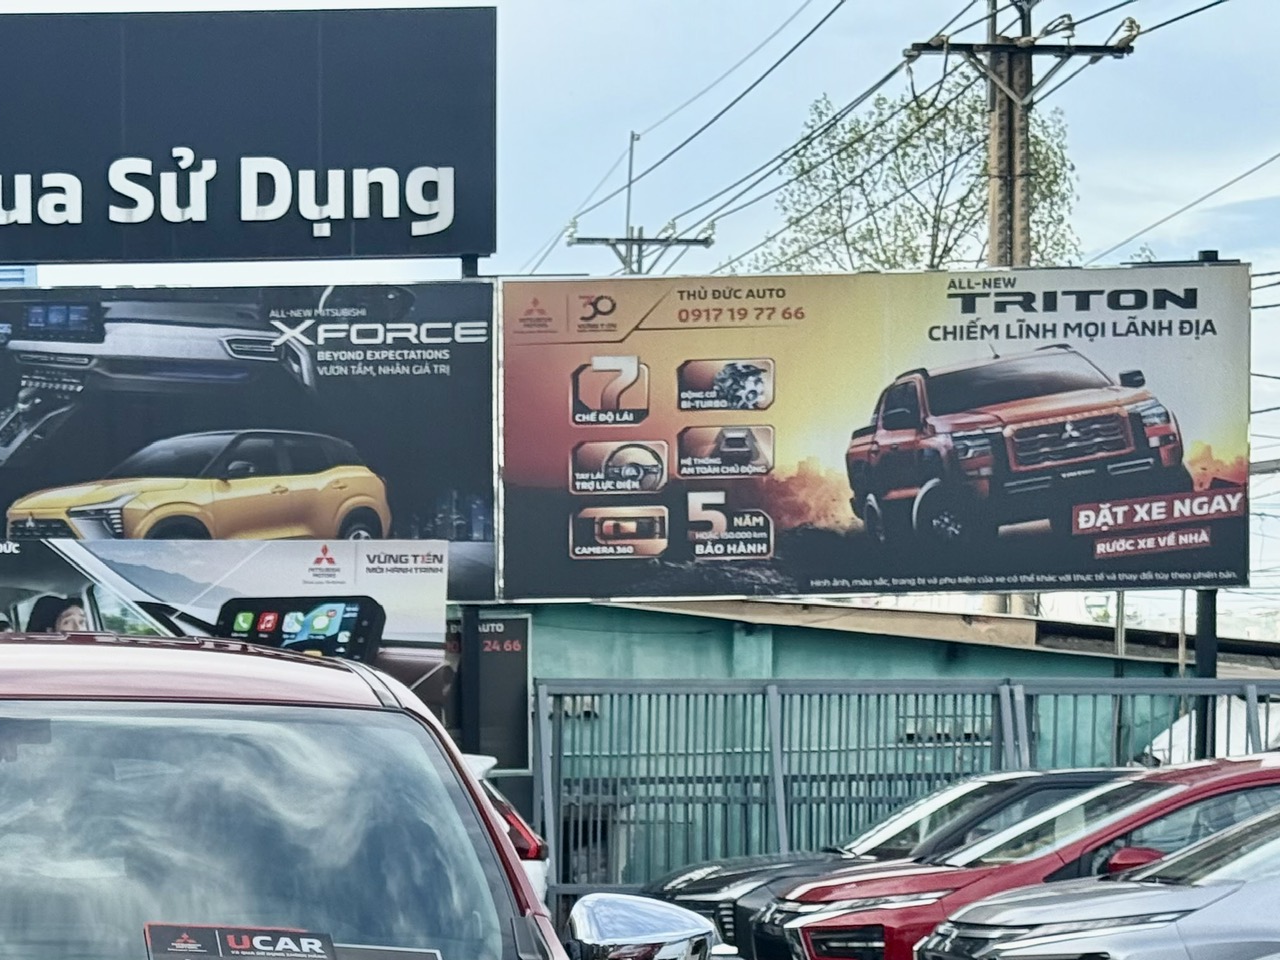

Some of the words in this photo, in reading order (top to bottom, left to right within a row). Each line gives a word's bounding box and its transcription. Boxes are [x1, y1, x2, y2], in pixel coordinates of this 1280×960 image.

[108, 146, 217, 225] Sử
[239, 156, 456, 237] Dụng
[947, 277, 1017, 290] ALL-NEW
[677, 287, 708, 300] THỦ
[711, 287, 742, 300] ĐỨC
[745, 287, 786, 299] AUTO
[946, 288, 1198, 314] TRITON
[270, 310, 312, 318] ALL-NEW
[315, 308, 367, 317] MITSUBISHI
[677, 307, 722, 323] 0917
[727, 308, 748, 321] 19
[753, 307, 777, 321] 77
[781, 306, 805, 320] 66
[270, 319, 488, 346] XFORCE
[928, 317, 1000, 341] CHIẾM
[1006, 318, 1057, 339] LĨNH
[1064, 321, 1106, 342] MỌI
[1113, 315, 1171, 337] LÃNH
[1179, 318, 1218, 340] ĐỊA
[317, 350, 364, 361] BEYOND
[367, 350, 450, 360] EXPECTATIONS
[591, 356, 639, 410] 7
[575, 411, 597, 422] CHẾ
[598, 411, 615, 423] ĐỘ
[616, 411, 634, 421] LÁI
[687, 491, 728, 541] 5
[1077, 503, 1130, 531] ĐẶT
[1133, 501, 1167, 522] XE
[1173, 492, 1243, 517] NGAY
[733, 514, 765, 527] NĂM
[695, 540, 725, 554] BẢO
[727, 540, 768, 554] HÀNH
[1137, 537, 1156, 549] XE
[1157, 531, 1177, 546] VỀ
[1179, 529, 1210, 544] NHÀ
[575, 546, 614, 555] CAMERA
[483, 640, 501, 652] 24
[503, 640, 521, 652] 66
[226, 934, 325, 954] UCAR
